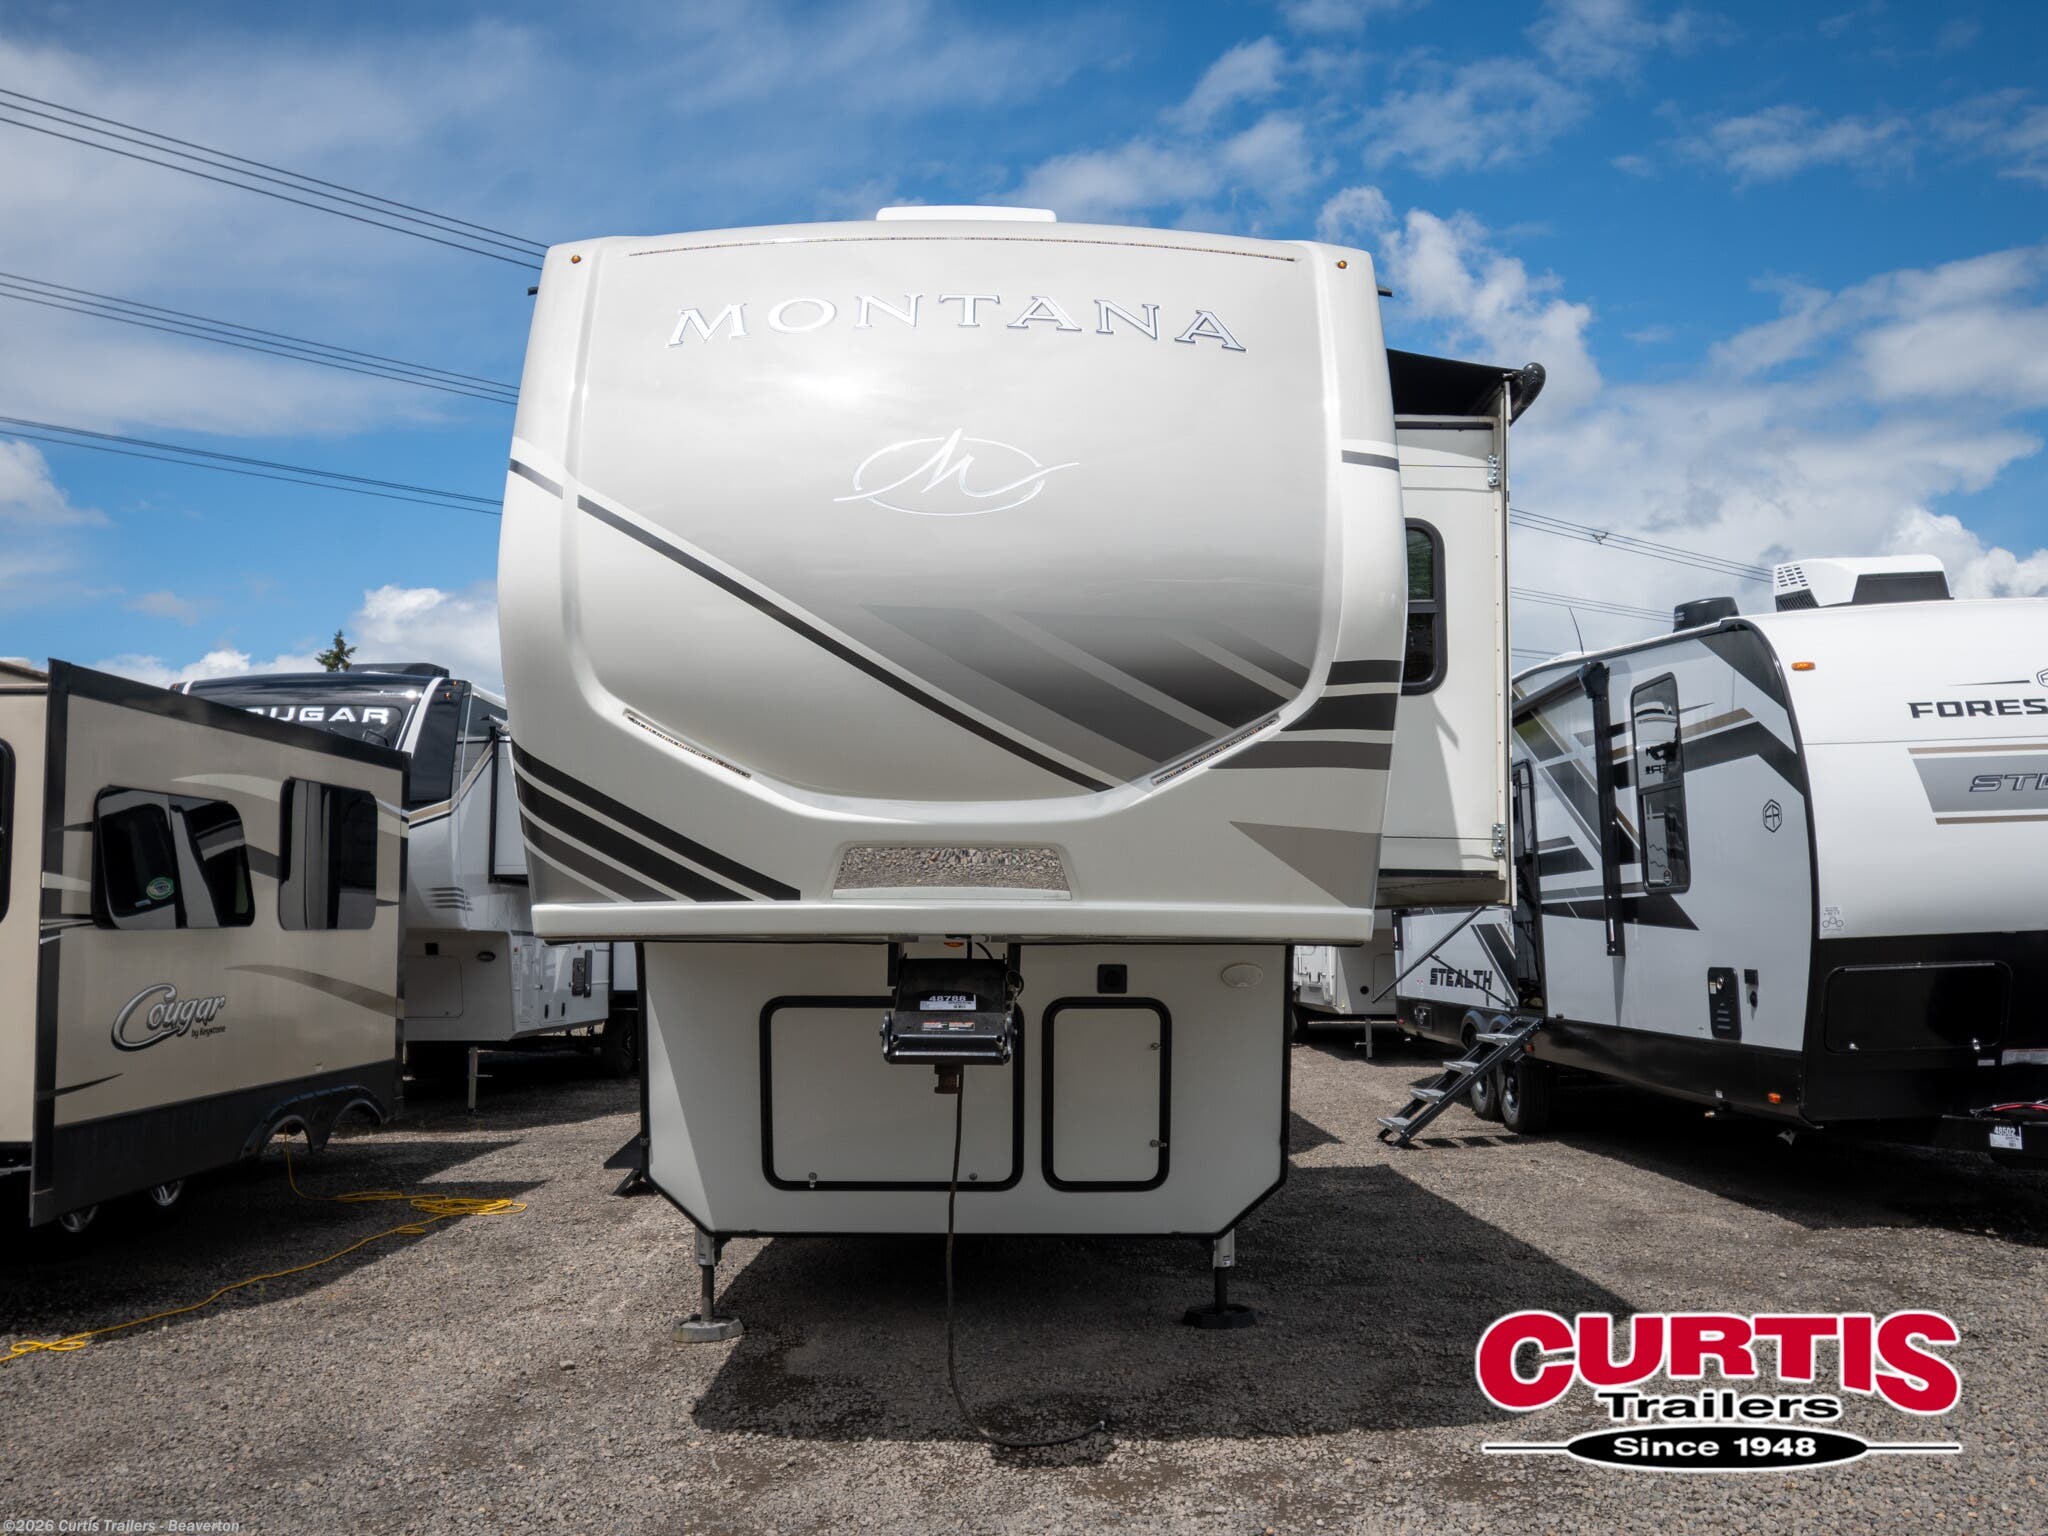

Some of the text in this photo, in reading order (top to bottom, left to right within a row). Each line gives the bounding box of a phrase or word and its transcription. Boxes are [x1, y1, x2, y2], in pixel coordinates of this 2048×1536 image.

[665, 293, 1247, 352] MONTANA
[1429, 967, 1494, 991] STEALTH
[111, 983, 226, 1052] Cougar
